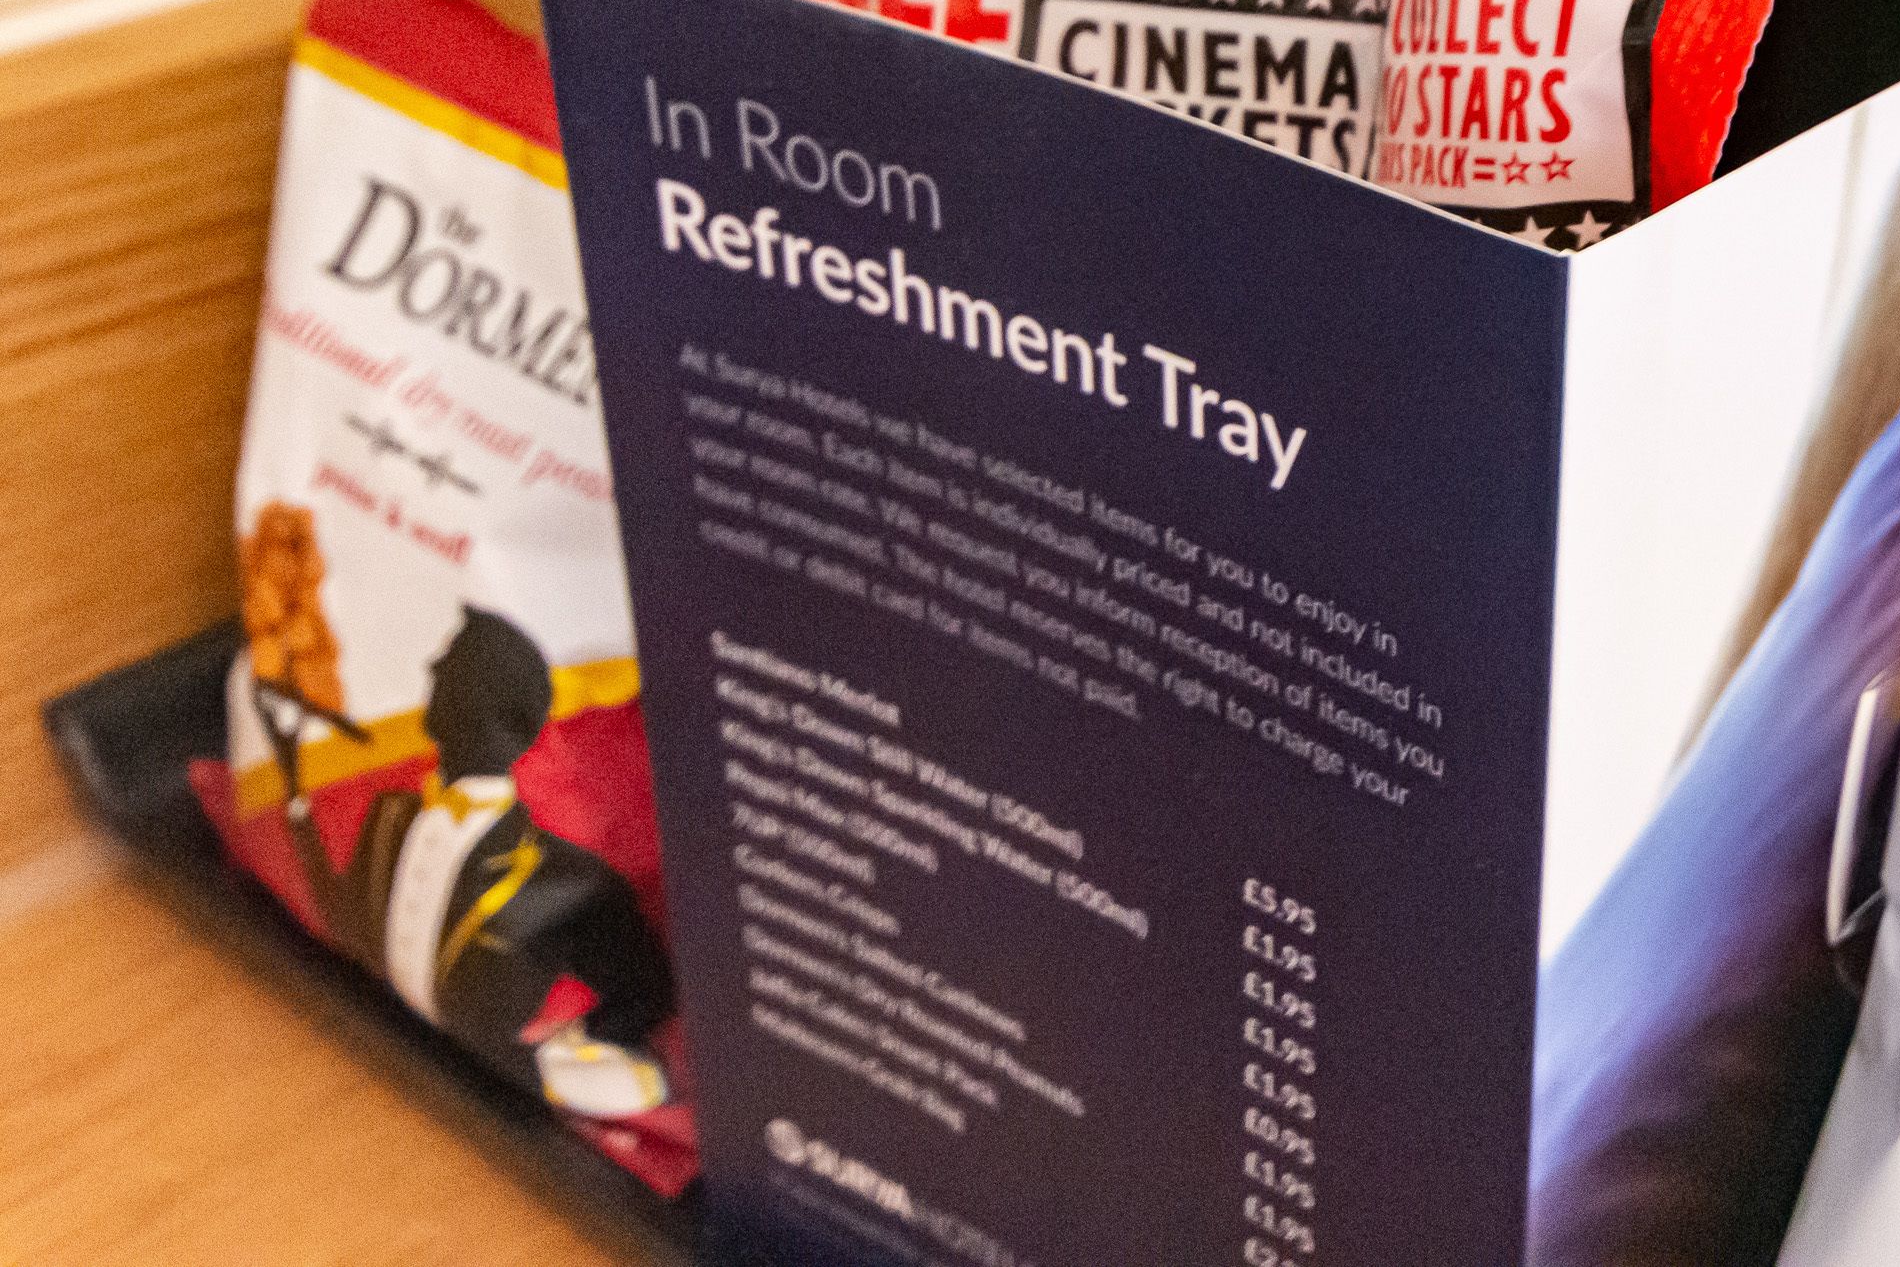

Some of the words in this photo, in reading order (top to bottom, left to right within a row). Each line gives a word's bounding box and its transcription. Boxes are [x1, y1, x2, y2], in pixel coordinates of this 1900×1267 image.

[1058, 19, 1359, 112] CINEMA
[1412, 64, 1573, 144] STARS
[645, 75, 712, 160] In
[736, 97, 943, 230] Room
[655, 177, 1129, 407] Refreshment
[1141, 342, 1307, 490] Tray
[983, 454, 1085, 514] selected
[1090, 494, 1159, 546] items
[1163, 527, 1199, 563] for
[1206, 553, 1255, 589] you
[1260, 571, 1289, 606] to
[1294, 591, 1367, 646] enjoy
[1372, 621, 1400, 657] in
[1074, 578, 1157, 637] inform
[1161, 623, 1281, 696] reception
[1285, 680, 1312, 712] of
[1318, 693, 1390, 752] items
[1395, 737, 1446, 778] you
[1112, 557, 1191, 609] priced
[1196, 595, 1245, 632] and
[1249, 618, 1295, 658] not
[1300, 637, 1411, 713] included
[1416, 691, 1442, 729] in
[1009, 601, 1111, 662] reserves
[1116, 644, 1158, 683] the
[1162, 668, 1220, 716] right
[1225, 696, 1255, 731] to
[1259, 718, 1346, 776] charge
[1350, 763, 1410, 807] your
[1243, 877, 1317, 936] £5.95
[1243, 924, 1317, 982] £1.95
[1243, 971, 1317, 1029] £1.95
[1243, 1017, 1317, 1075] £1.95
[1243, 1063, 1317, 1120] £1.95
